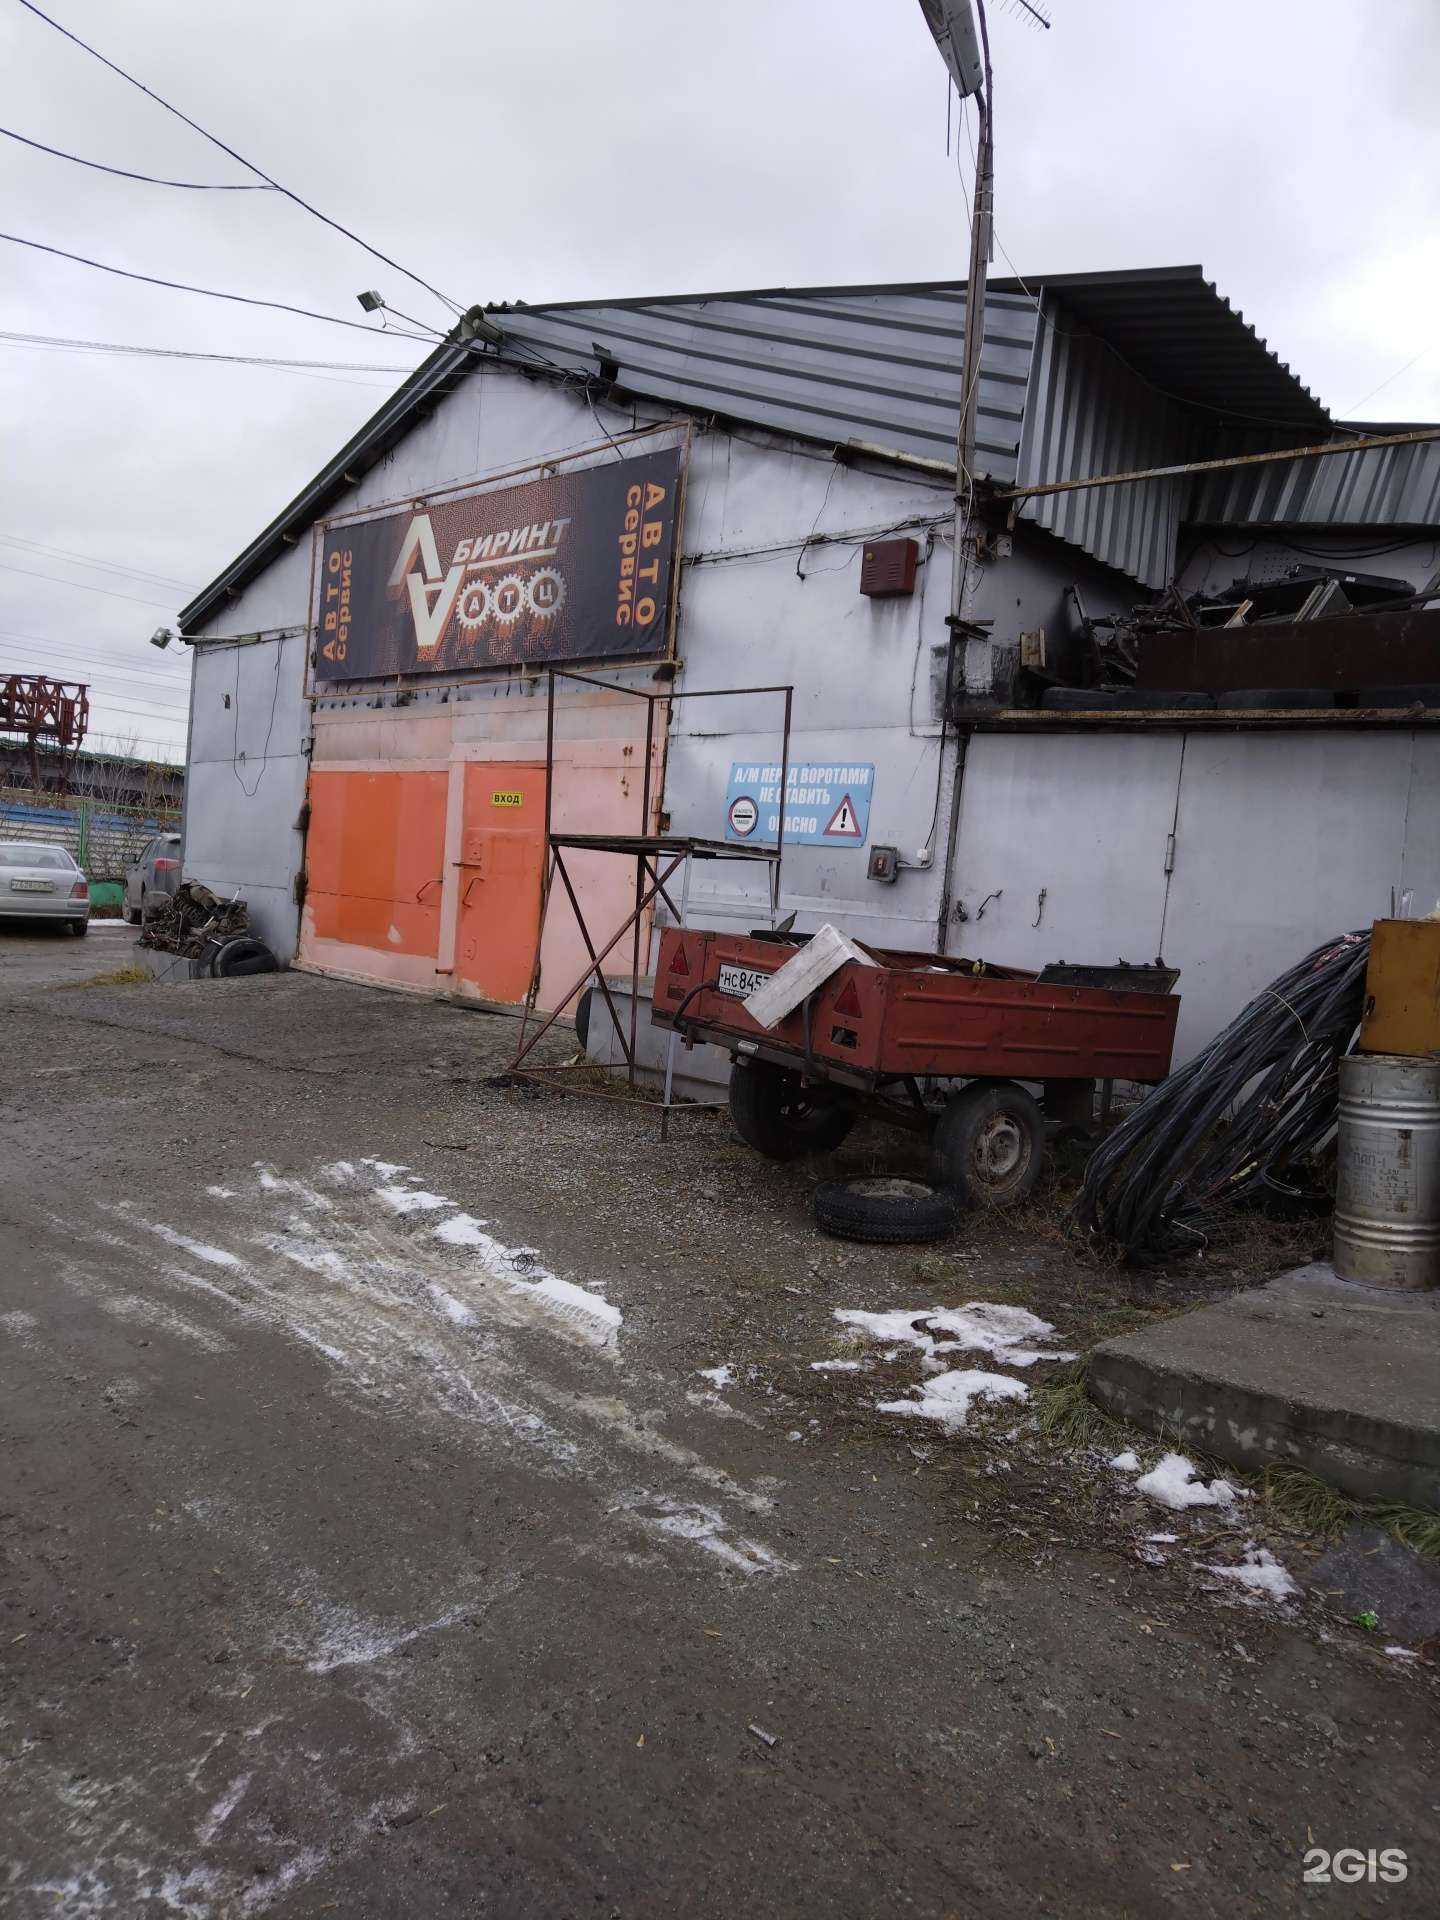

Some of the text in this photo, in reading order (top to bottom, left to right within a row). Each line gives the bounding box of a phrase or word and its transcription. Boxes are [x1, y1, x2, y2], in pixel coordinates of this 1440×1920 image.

[635, 482, 666, 626] АВТО
[323, 552, 341, 661] АВТО
[733, 767, 869, 786] А/М ПЕРД ВОРОТАМИ
[494, 795, 519, 804] ВХОД
[760, 787, 775, 803] НЕ
